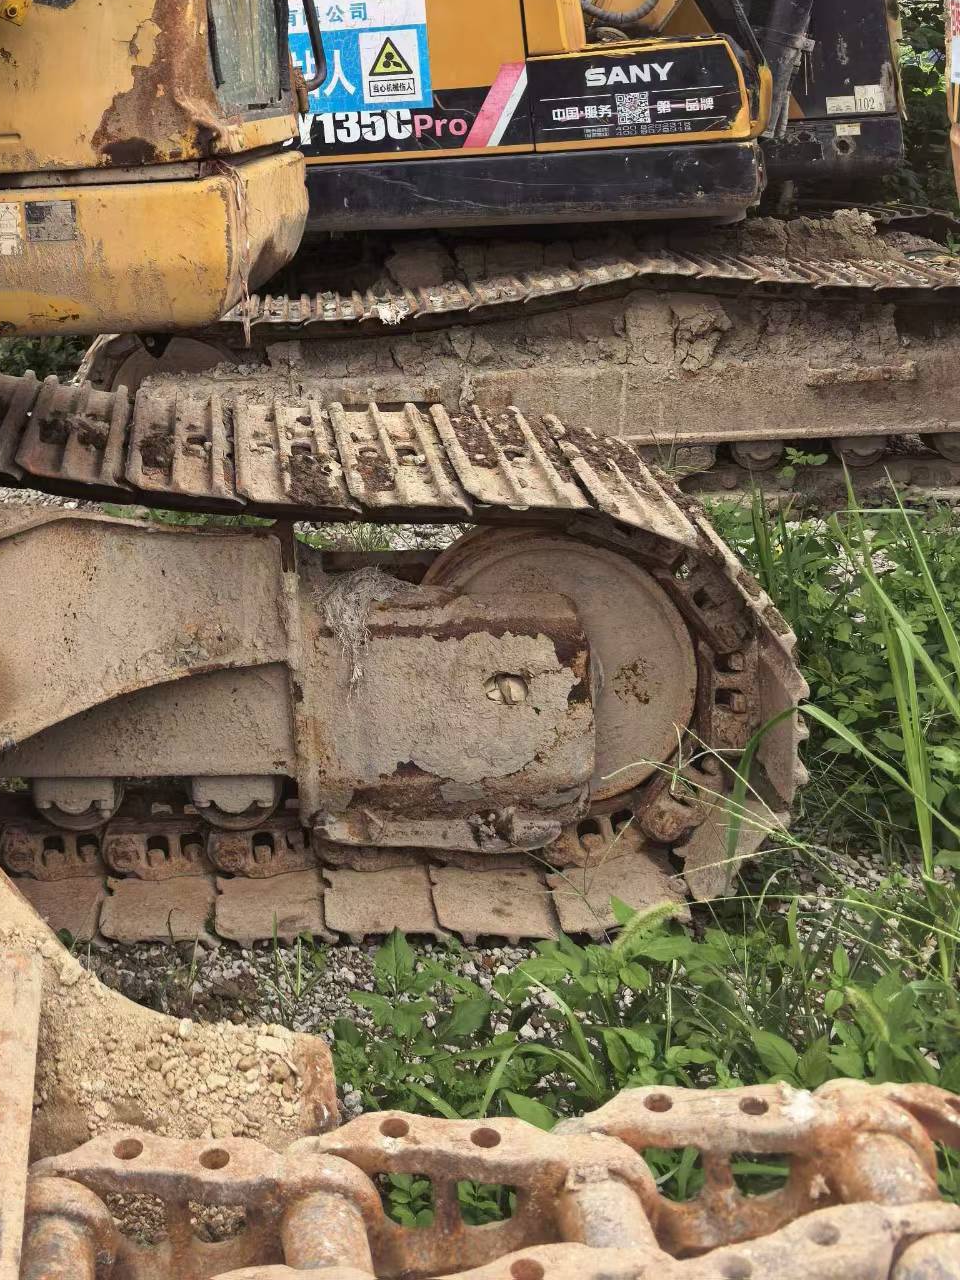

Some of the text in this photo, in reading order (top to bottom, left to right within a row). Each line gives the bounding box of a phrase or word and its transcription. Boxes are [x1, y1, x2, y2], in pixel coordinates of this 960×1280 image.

[584, 62, 674, 87] SANY
[372, 81, 414, 93] 当心机械伤人
